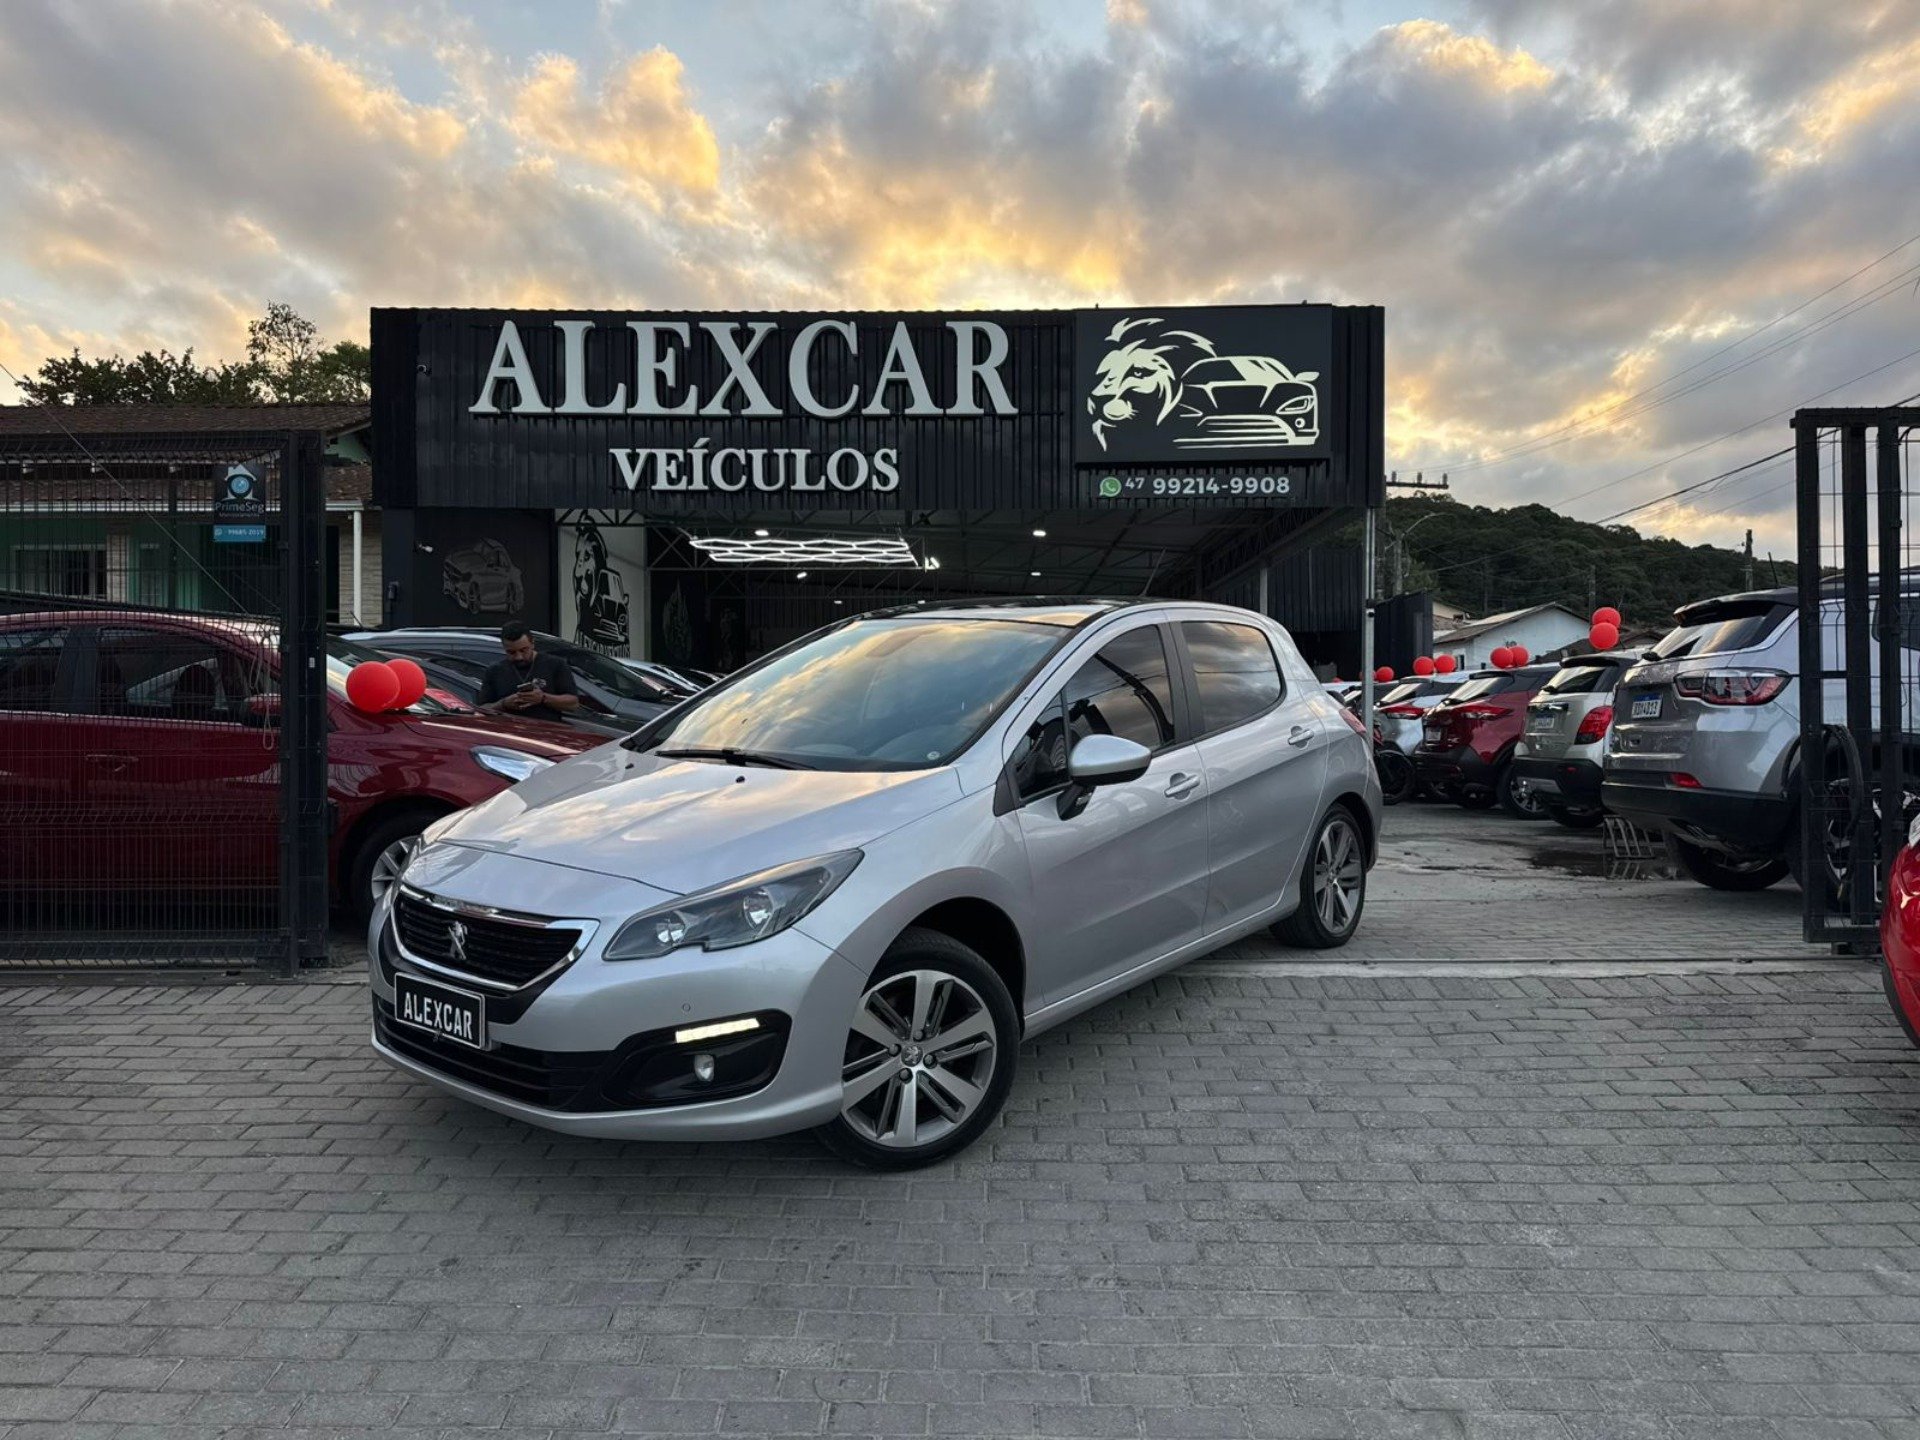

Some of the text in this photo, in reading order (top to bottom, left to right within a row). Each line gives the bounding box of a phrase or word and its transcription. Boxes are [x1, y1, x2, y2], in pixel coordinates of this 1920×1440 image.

[468, 319, 1019, 418] ALEXCAR
[609, 437, 900, 493] VEÍCULOS
[1125, 477, 1290, 494] 47 99214-9908
[215, 501, 265, 514] PrimeSeg
[403, 991, 473, 1040] ALEXCAR
